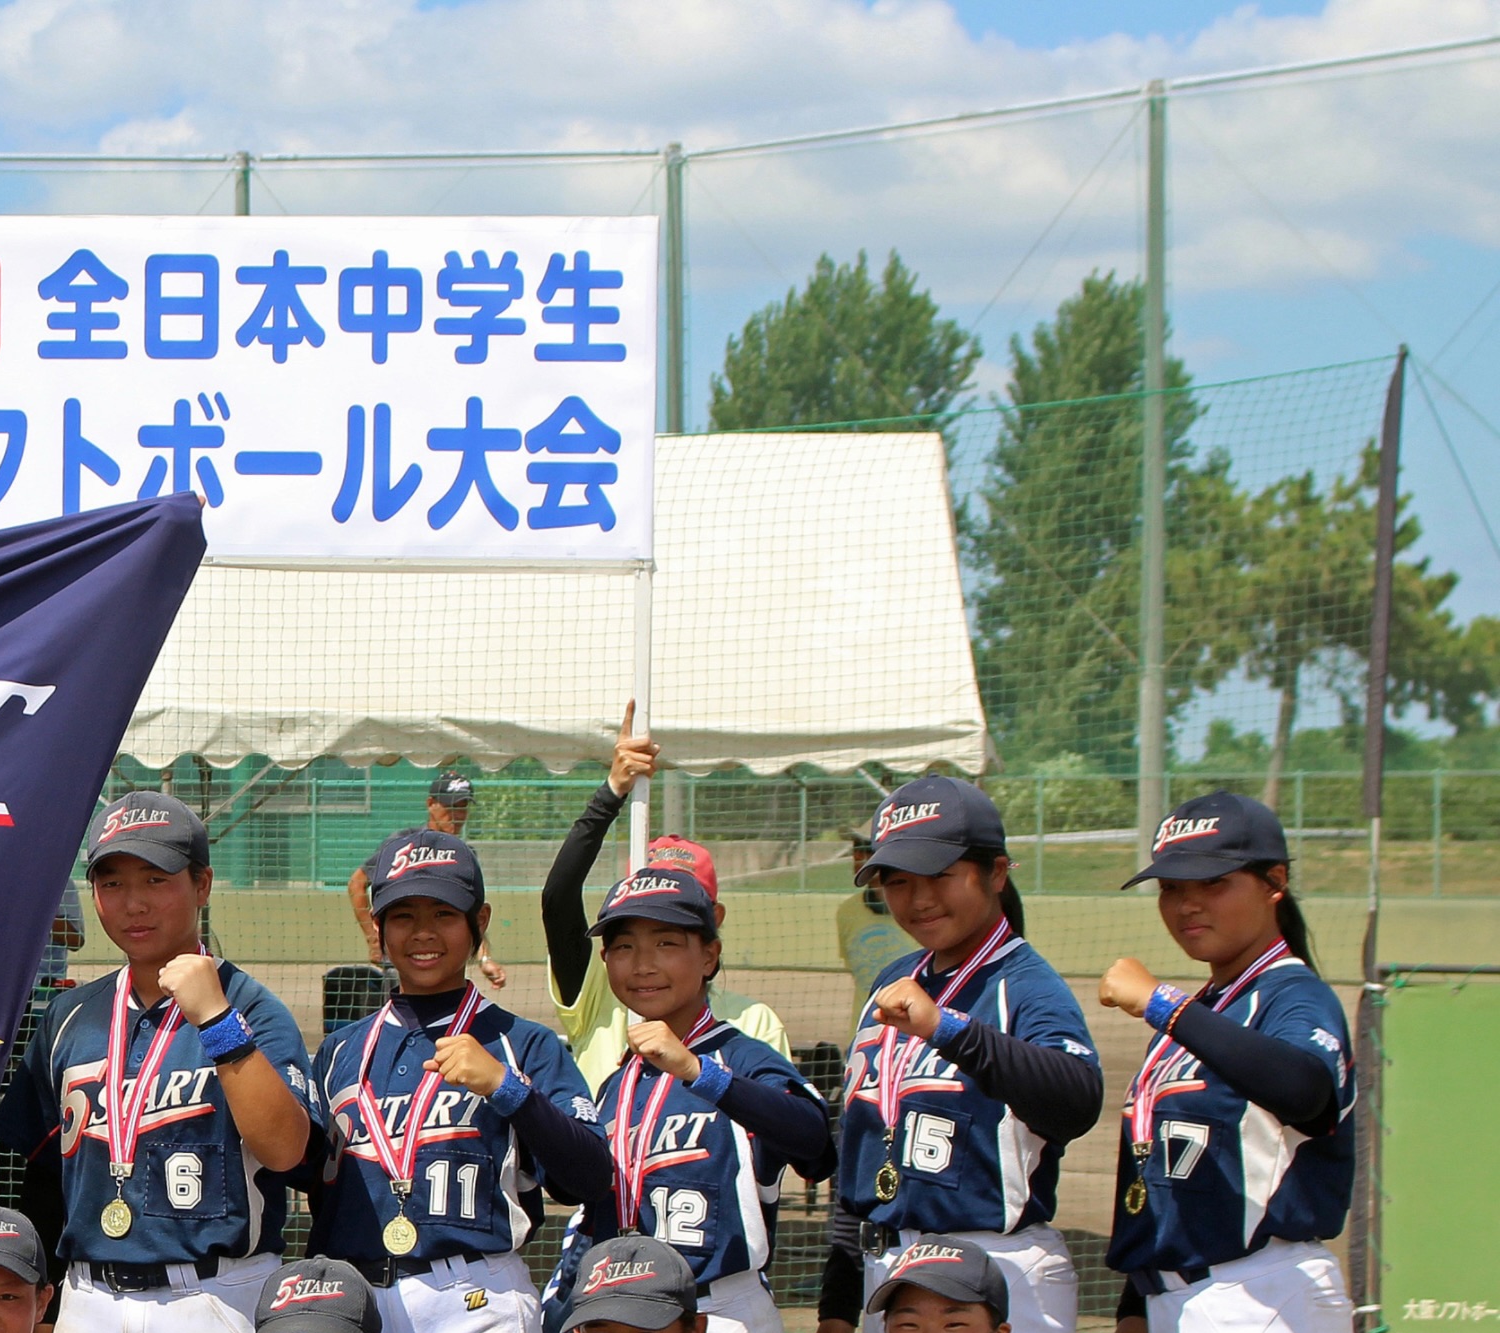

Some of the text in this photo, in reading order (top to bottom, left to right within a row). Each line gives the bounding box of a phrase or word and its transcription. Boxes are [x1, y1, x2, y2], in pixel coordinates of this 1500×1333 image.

[37, 247, 628, 365] 全日本中学生
[98, 807, 170, 843] 5START
[875, 803, 941, 842] 5START
[386, 843, 457, 879] 5START
[608, 875, 680, 908] 5START
[902, 1111, 955, 1173] 15
[1160, 1121, 1209, 1179] 17
[165, 1152, 203, 1209] 6
[425, 1160, 479, 1218] 11
[650, 1187, 708, 1246] 12
[582, 1256, 657, 1294] 5START
[889, 1242, 963, 1278] 5START
[270, 1274, 345, 1310] 5START
